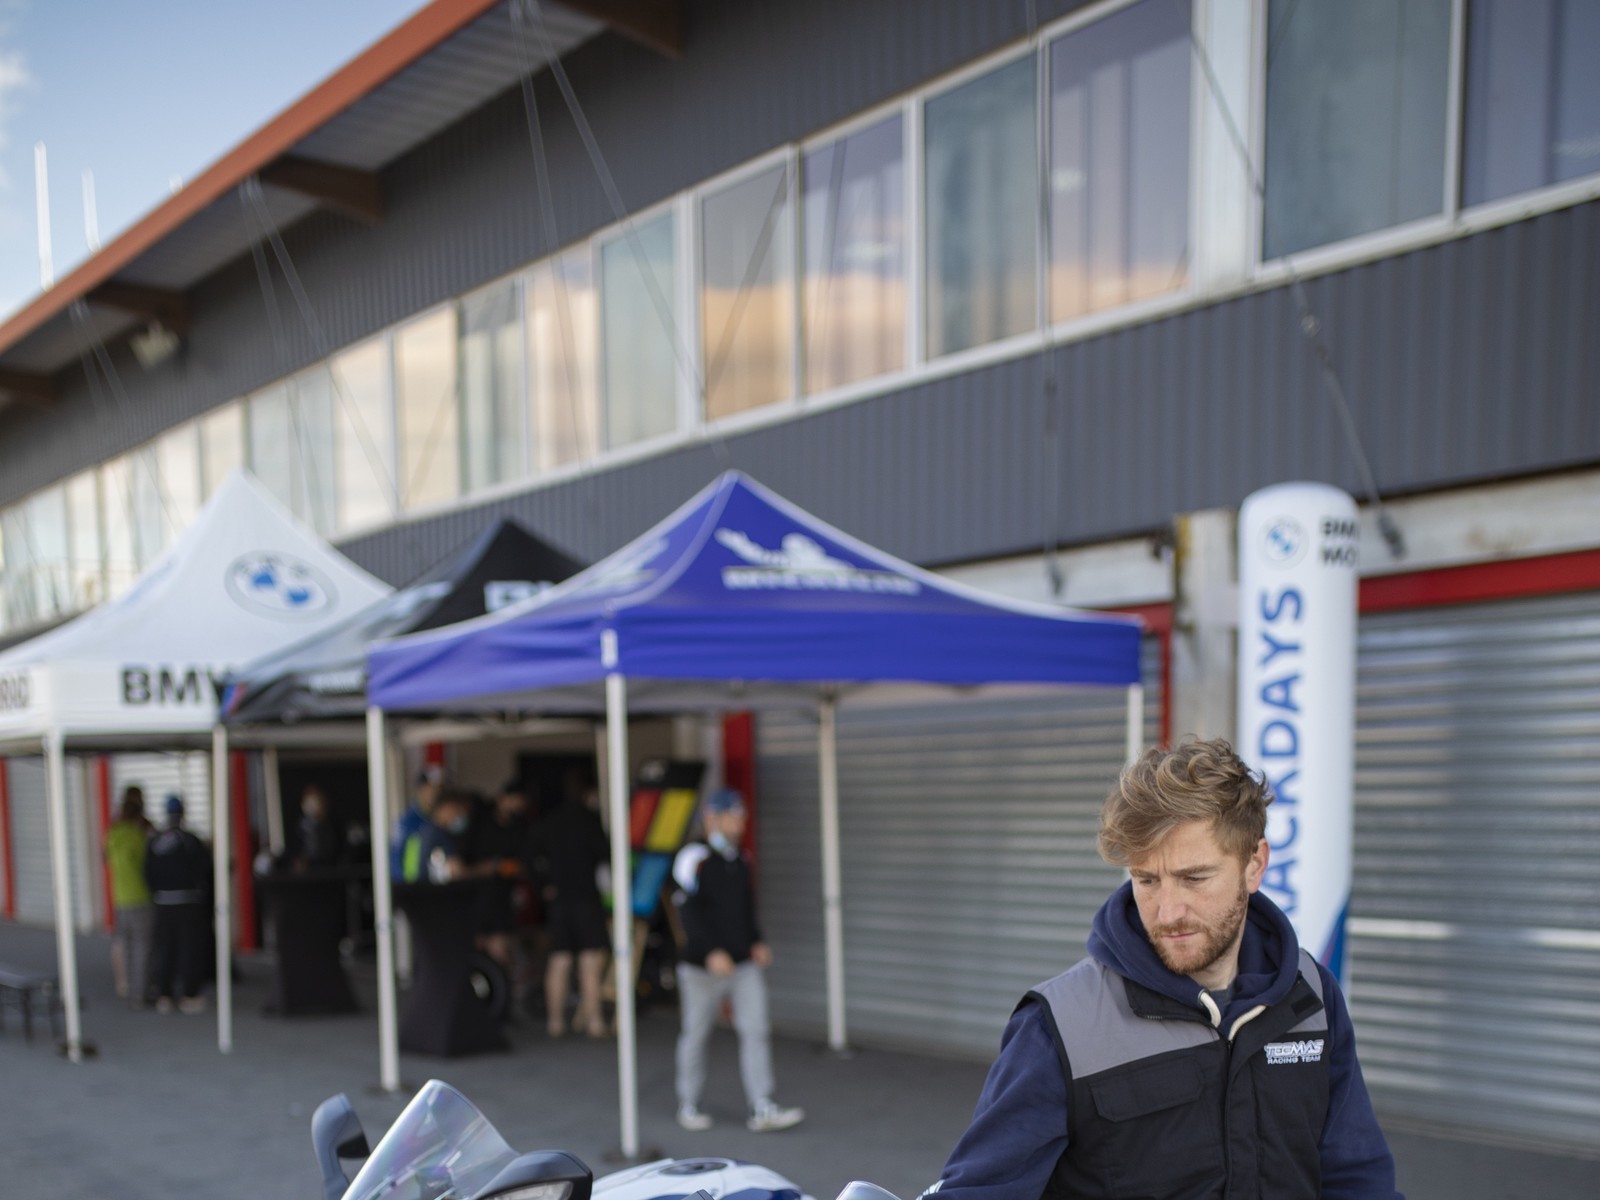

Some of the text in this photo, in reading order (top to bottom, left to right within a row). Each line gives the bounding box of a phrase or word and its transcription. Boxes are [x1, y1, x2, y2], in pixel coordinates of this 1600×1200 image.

[1259, 587, 1303, 918] ACKDAYS
[1264, 1039, 1324, 1057] TECMAS
[1267, 1055, 1321, 1065] RACING TEAM
